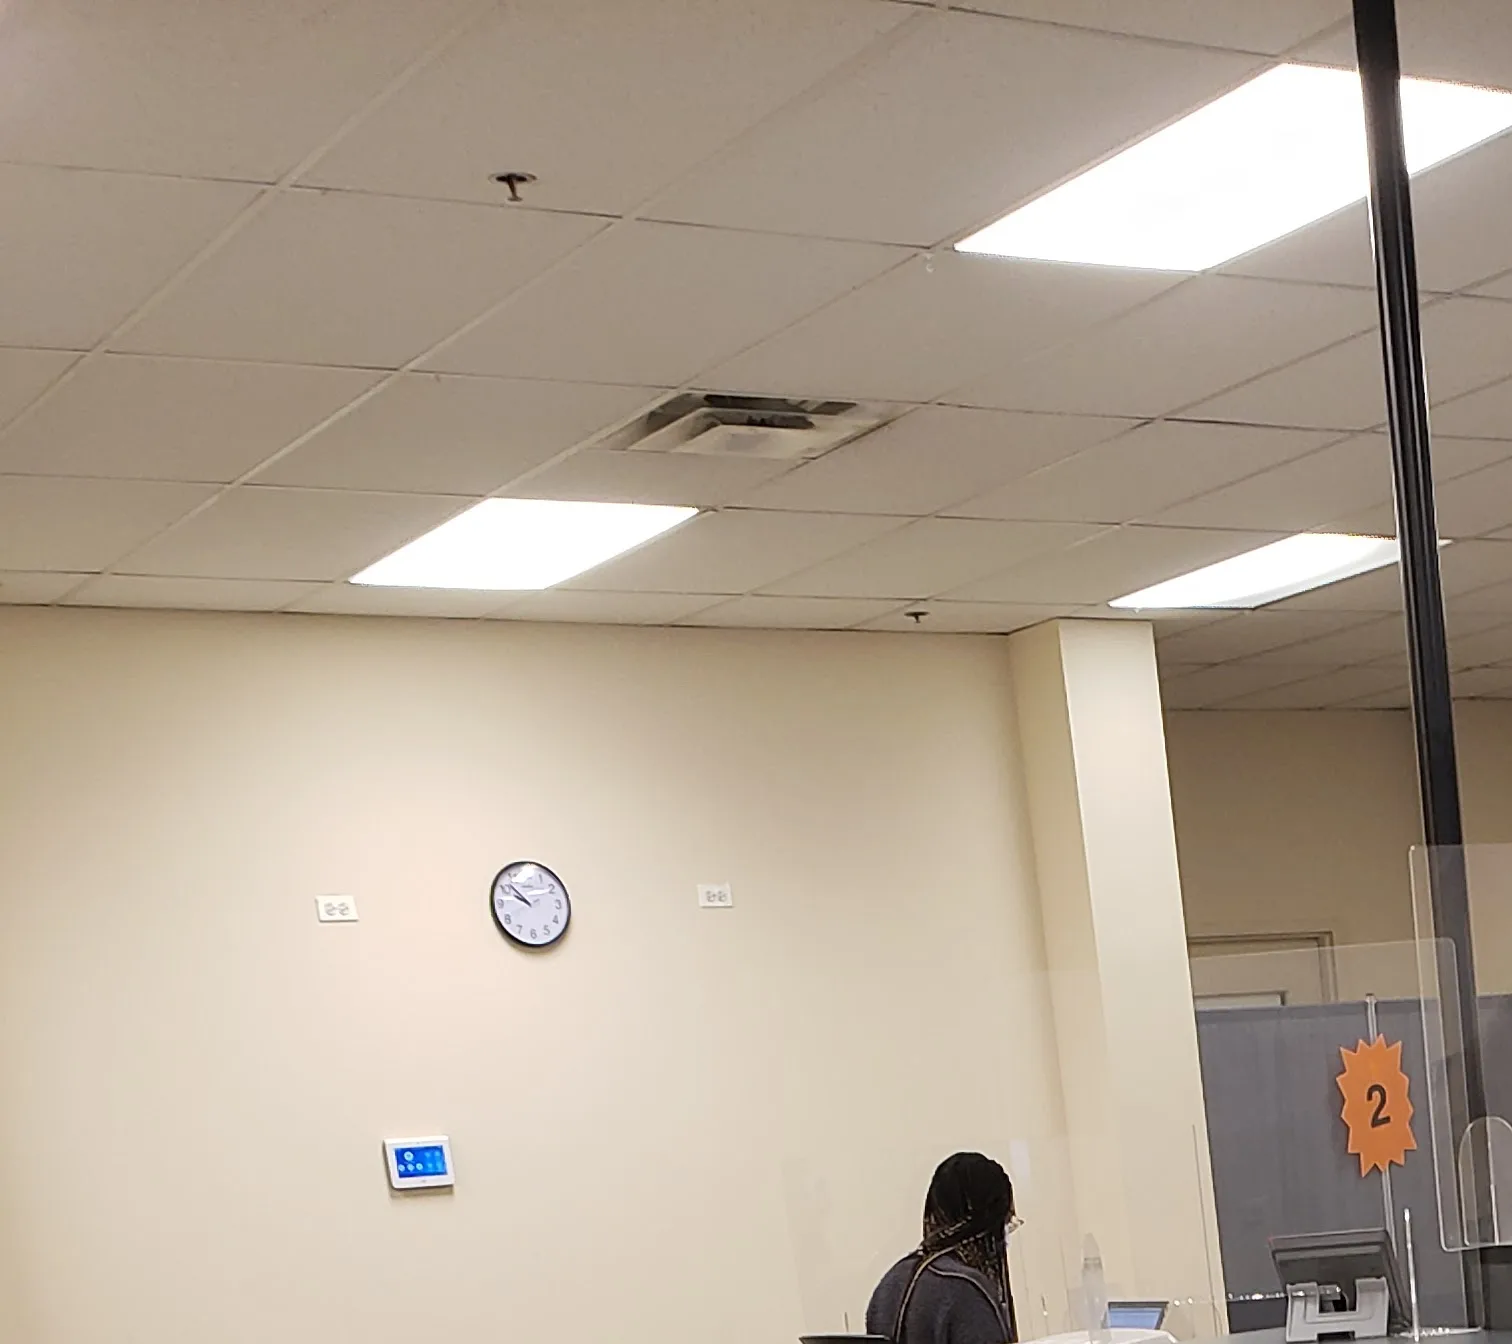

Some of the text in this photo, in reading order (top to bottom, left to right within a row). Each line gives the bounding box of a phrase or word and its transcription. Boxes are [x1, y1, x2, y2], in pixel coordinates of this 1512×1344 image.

[548, 883, 556, 894] 2
[555, 899, 562, 910] 3
[504, 913, 512, 925] 8
[552, 914, 559, 925] 4
[516, 924, 523, 935] 7
[530, 928, 537, 939] 6
[543, 924, 551, 936] 5
[1366, 1084, 1391, 1128] 2
